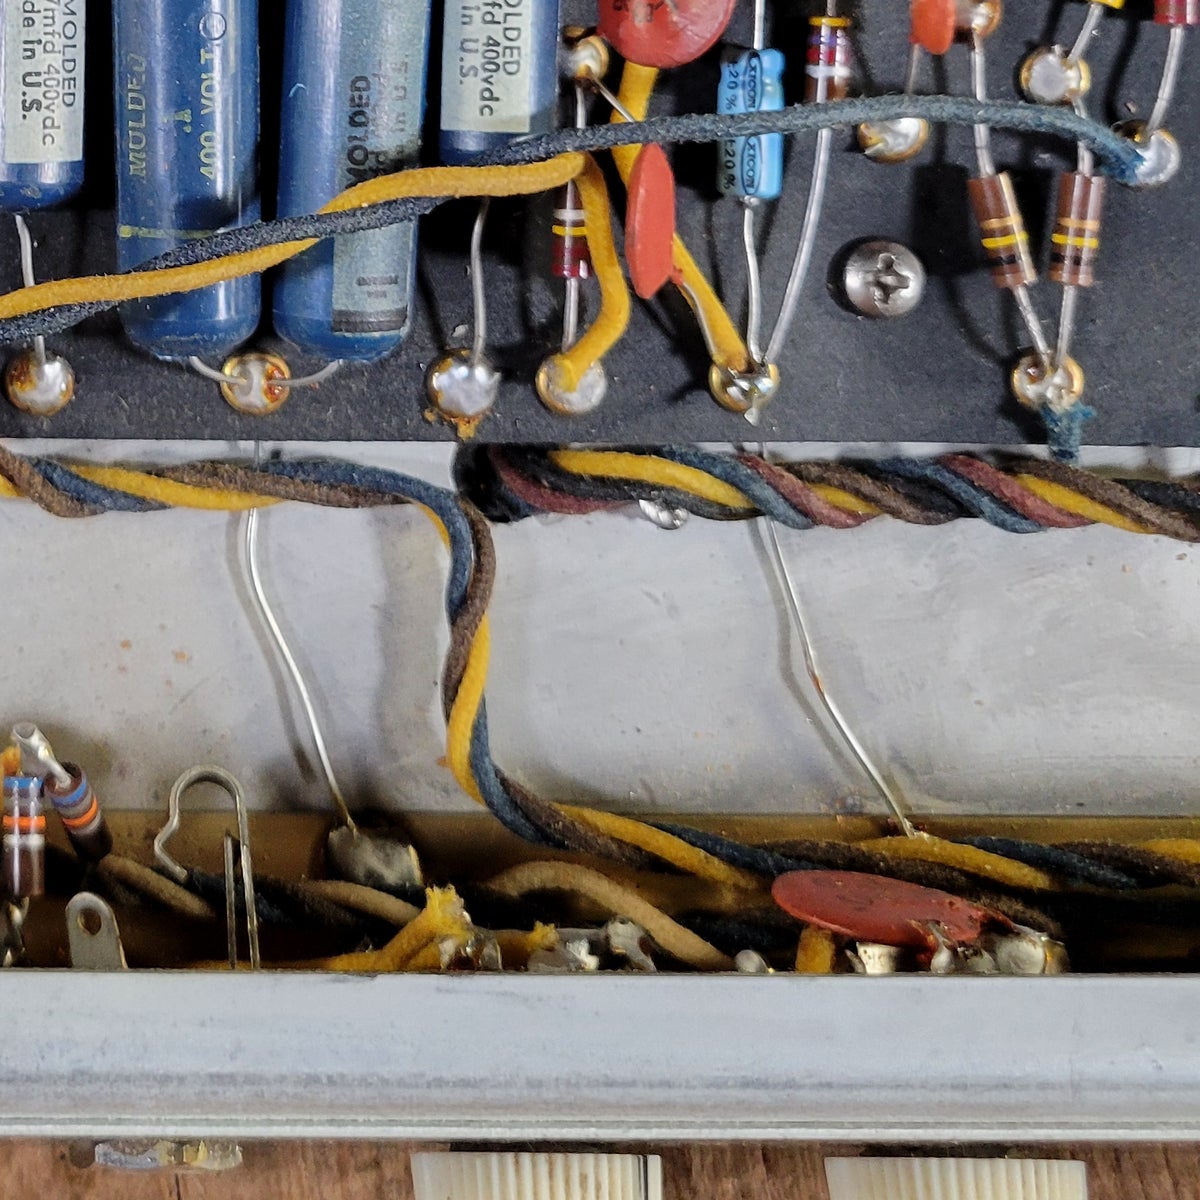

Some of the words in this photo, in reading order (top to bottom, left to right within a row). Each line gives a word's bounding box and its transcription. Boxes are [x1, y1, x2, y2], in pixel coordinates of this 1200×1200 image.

[461, 5, 480, 25] in
[22, 39, 41, 60] in
[459, 38, 479, 85] U.S.
[21, 71, 41, 120] U.S.
[200, 49, 219, 115] VOLT
[479, 35, 500, 117] 400vdc
[747, 65, 757, 108] XICON
[42, 64, 59, 146] 400vdc
[200, 131, 219, 181] 400
[746, 142, 756, 188] XICON
